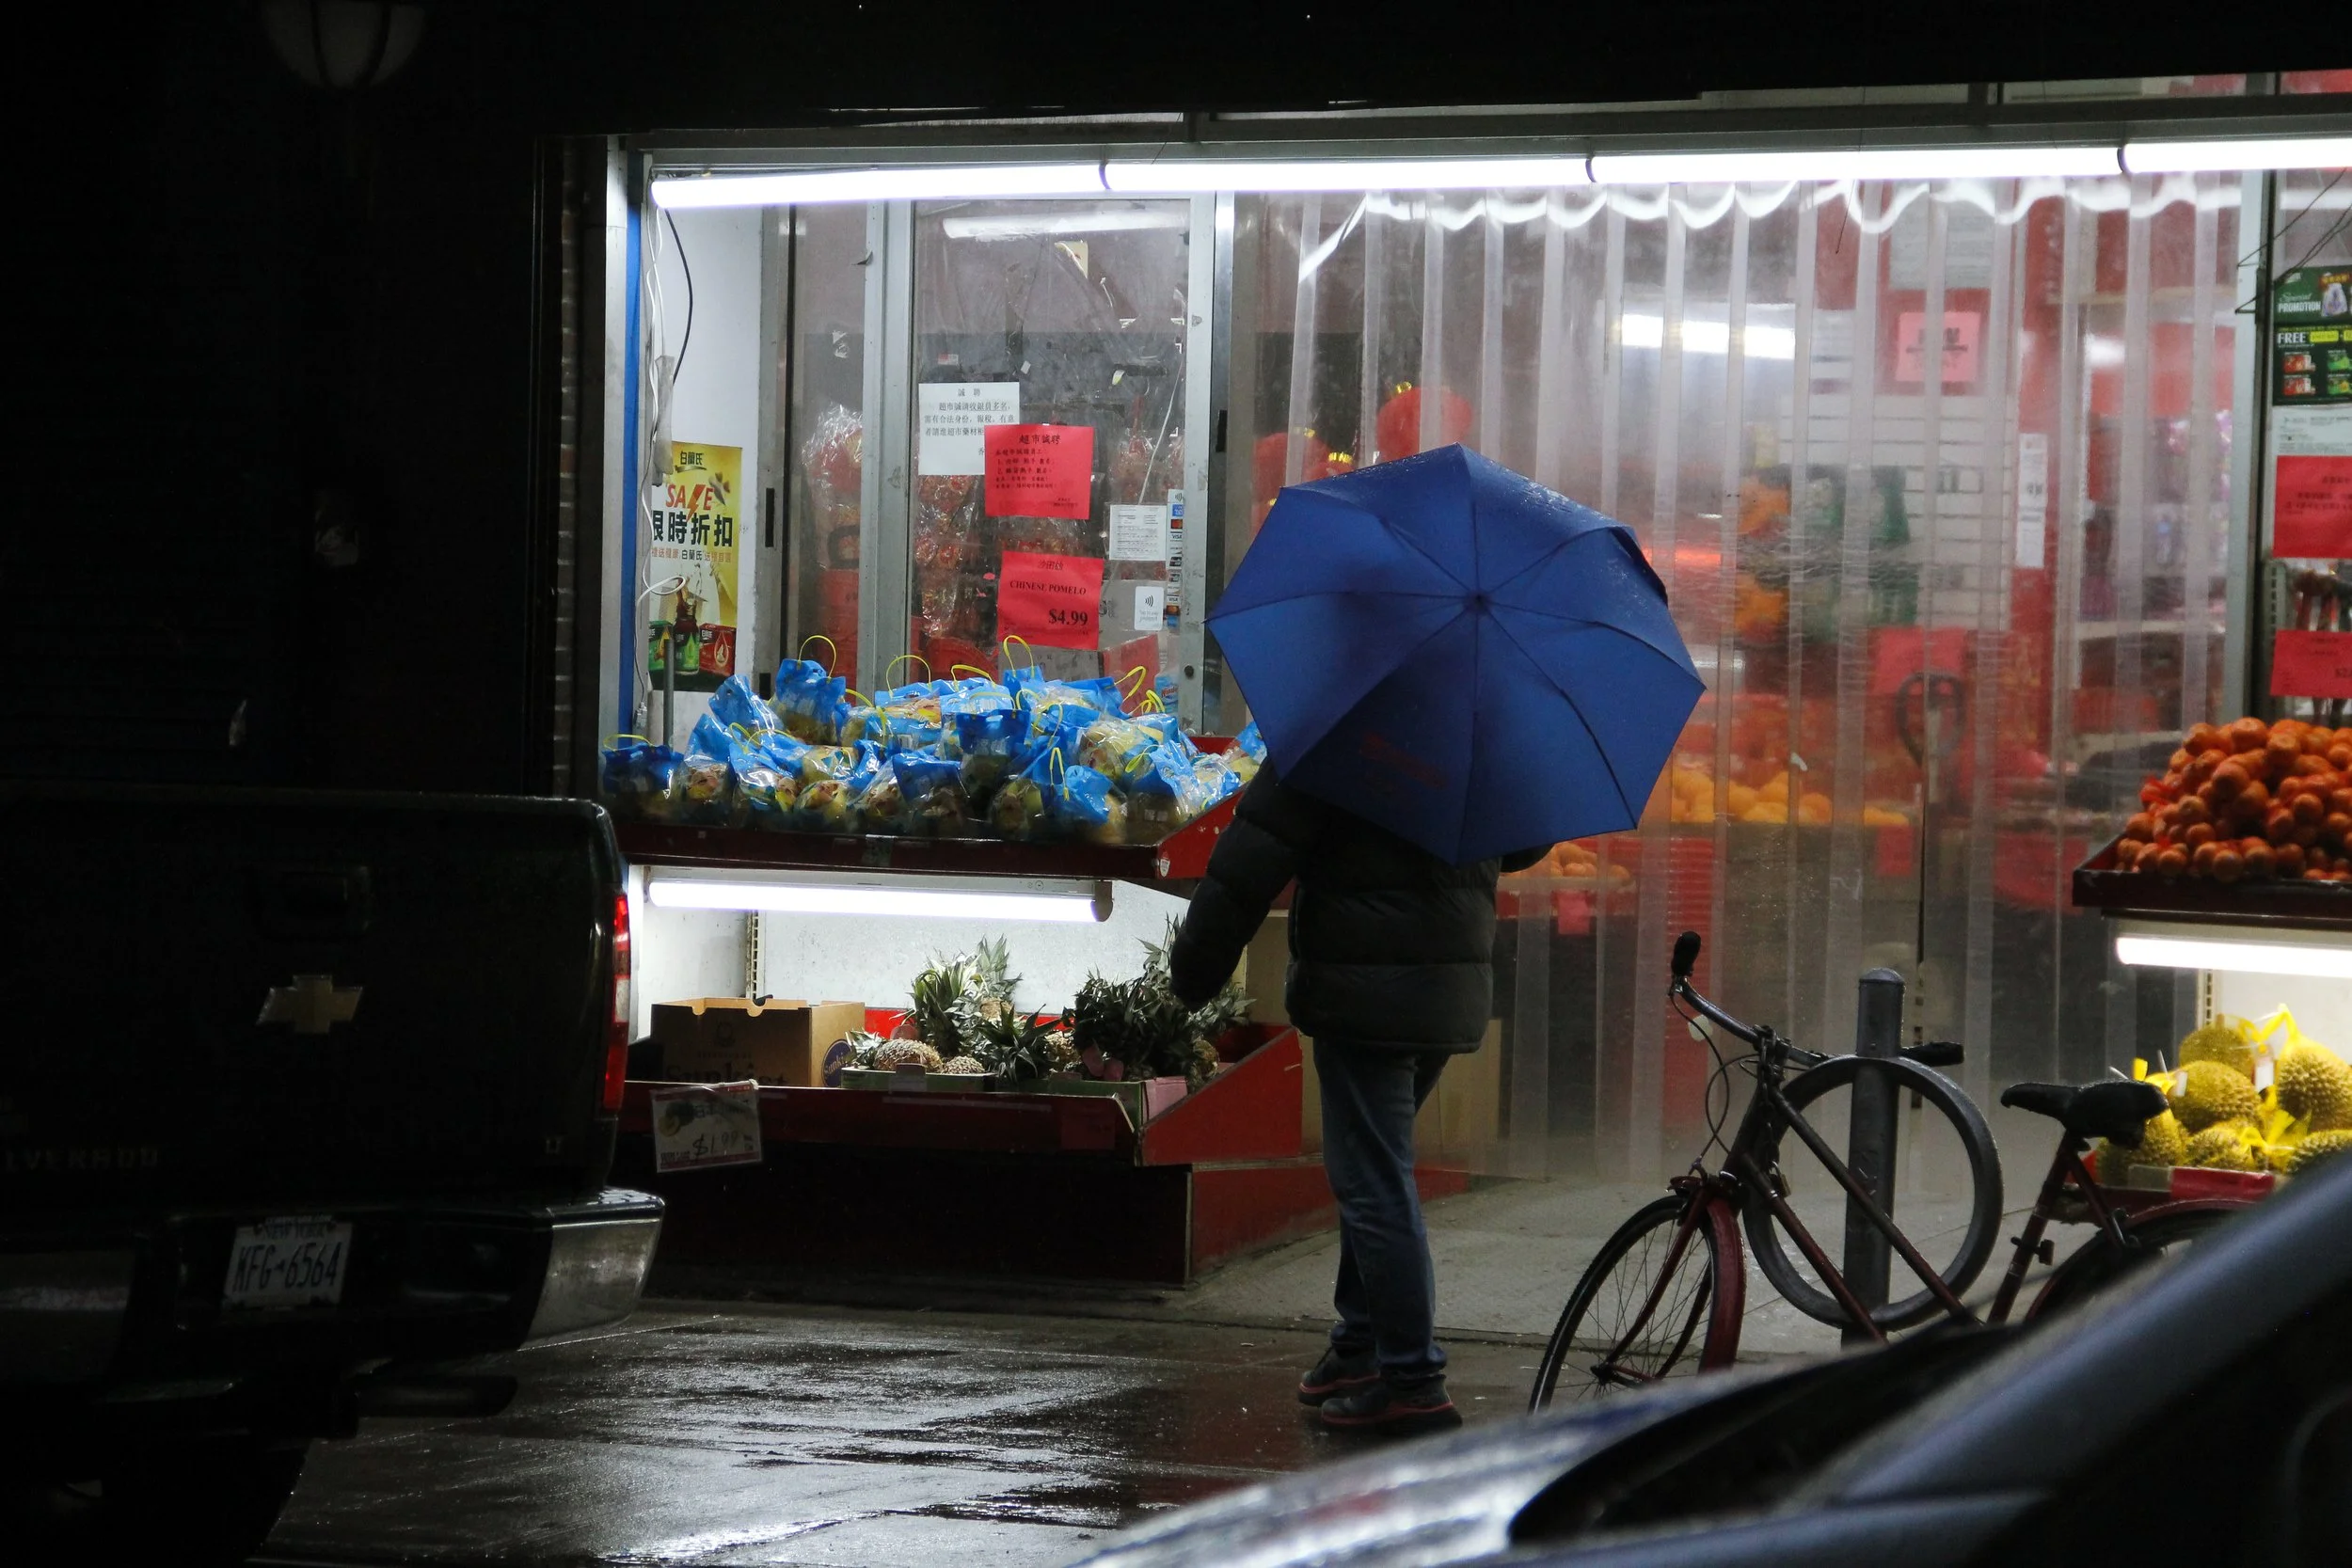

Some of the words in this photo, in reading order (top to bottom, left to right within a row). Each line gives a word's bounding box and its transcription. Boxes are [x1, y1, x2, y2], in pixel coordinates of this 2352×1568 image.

[2278, 301, 2322, 313] PROMOTION
[2277, 332, 2307, 344] FREE
[680, 451, 704, 466] 白蘭氏
[1009, 579, 1045, 592] CHINESE
[1049, 584, 1087, 595] POMELO
[1048, 609, 1089, 626] $4.99
